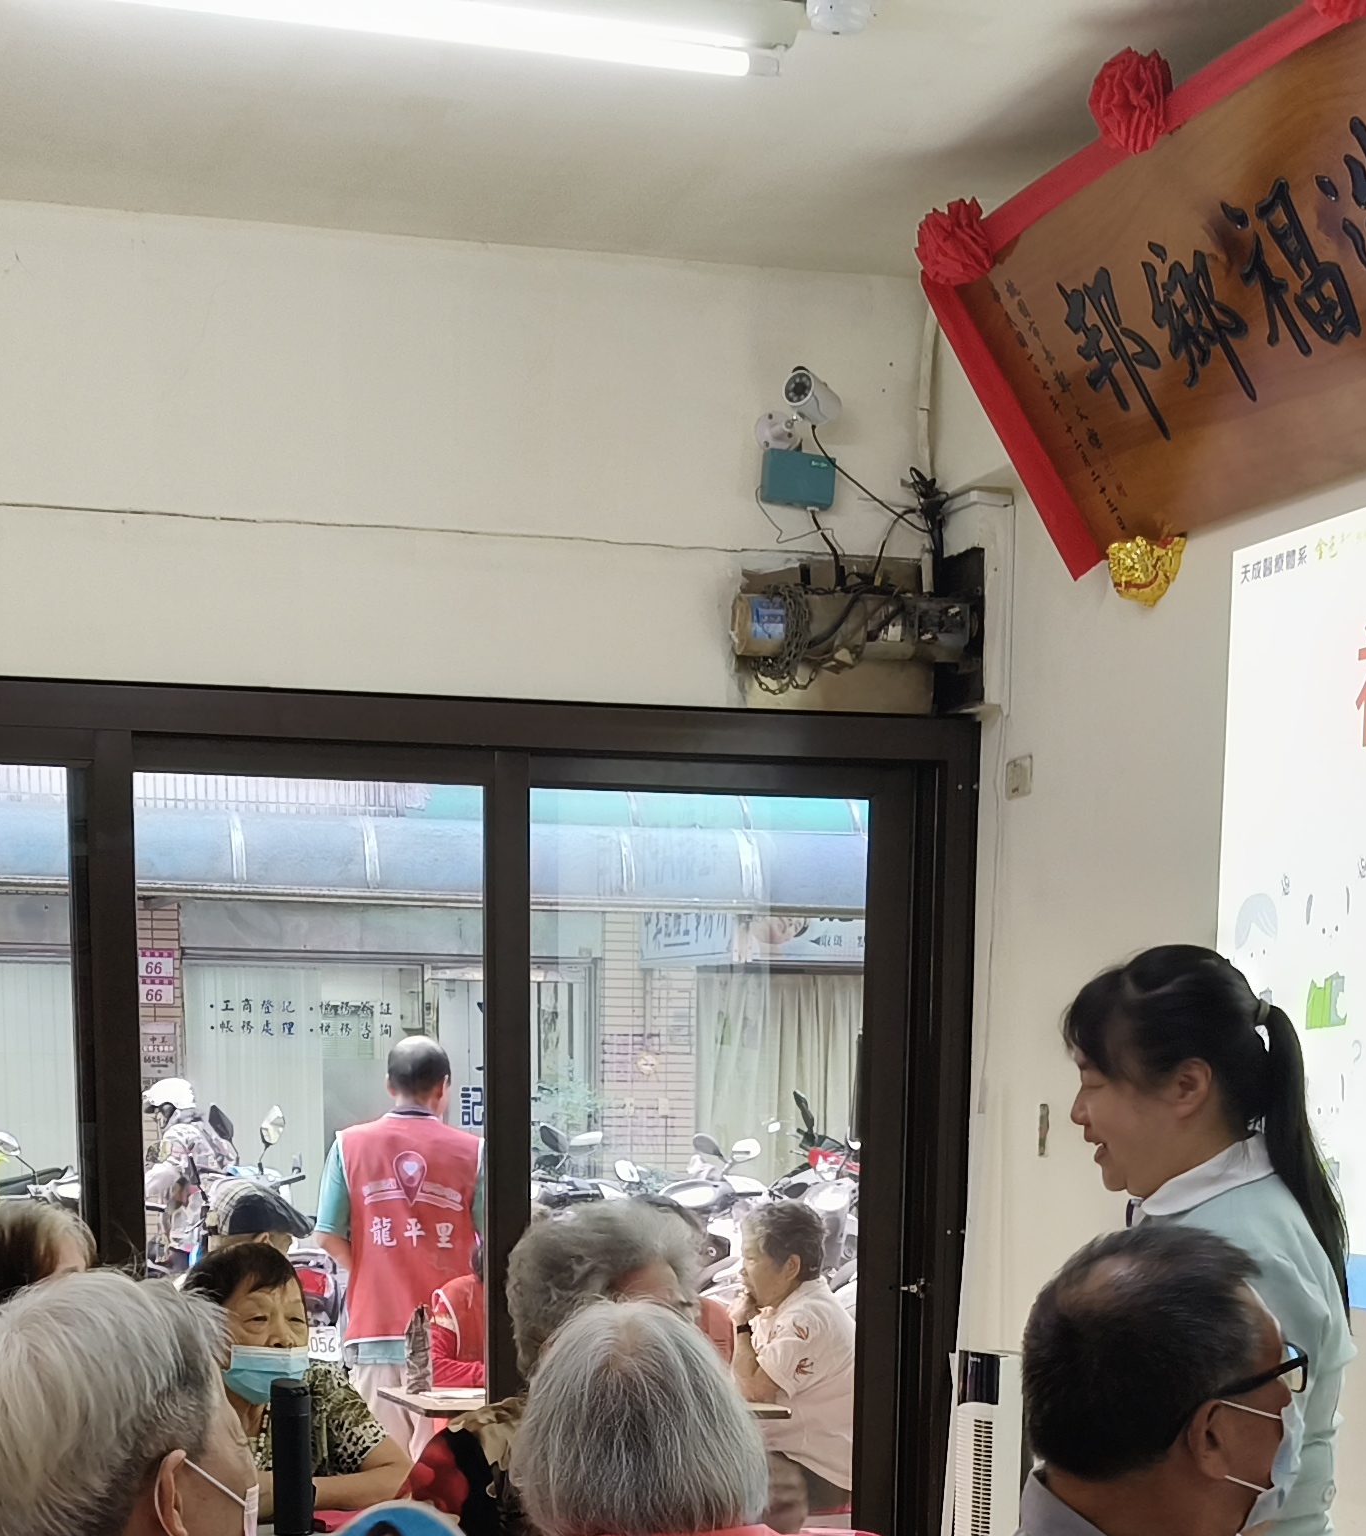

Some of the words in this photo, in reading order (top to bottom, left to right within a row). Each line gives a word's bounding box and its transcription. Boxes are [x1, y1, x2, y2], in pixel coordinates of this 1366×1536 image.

[1239, 544, 1309, 585] 天成醫療體系
[145, 961, 163, 975] 66
[145, 988, 163, 1002] 66
[369, 1215, 455, 1250] 龍平里
